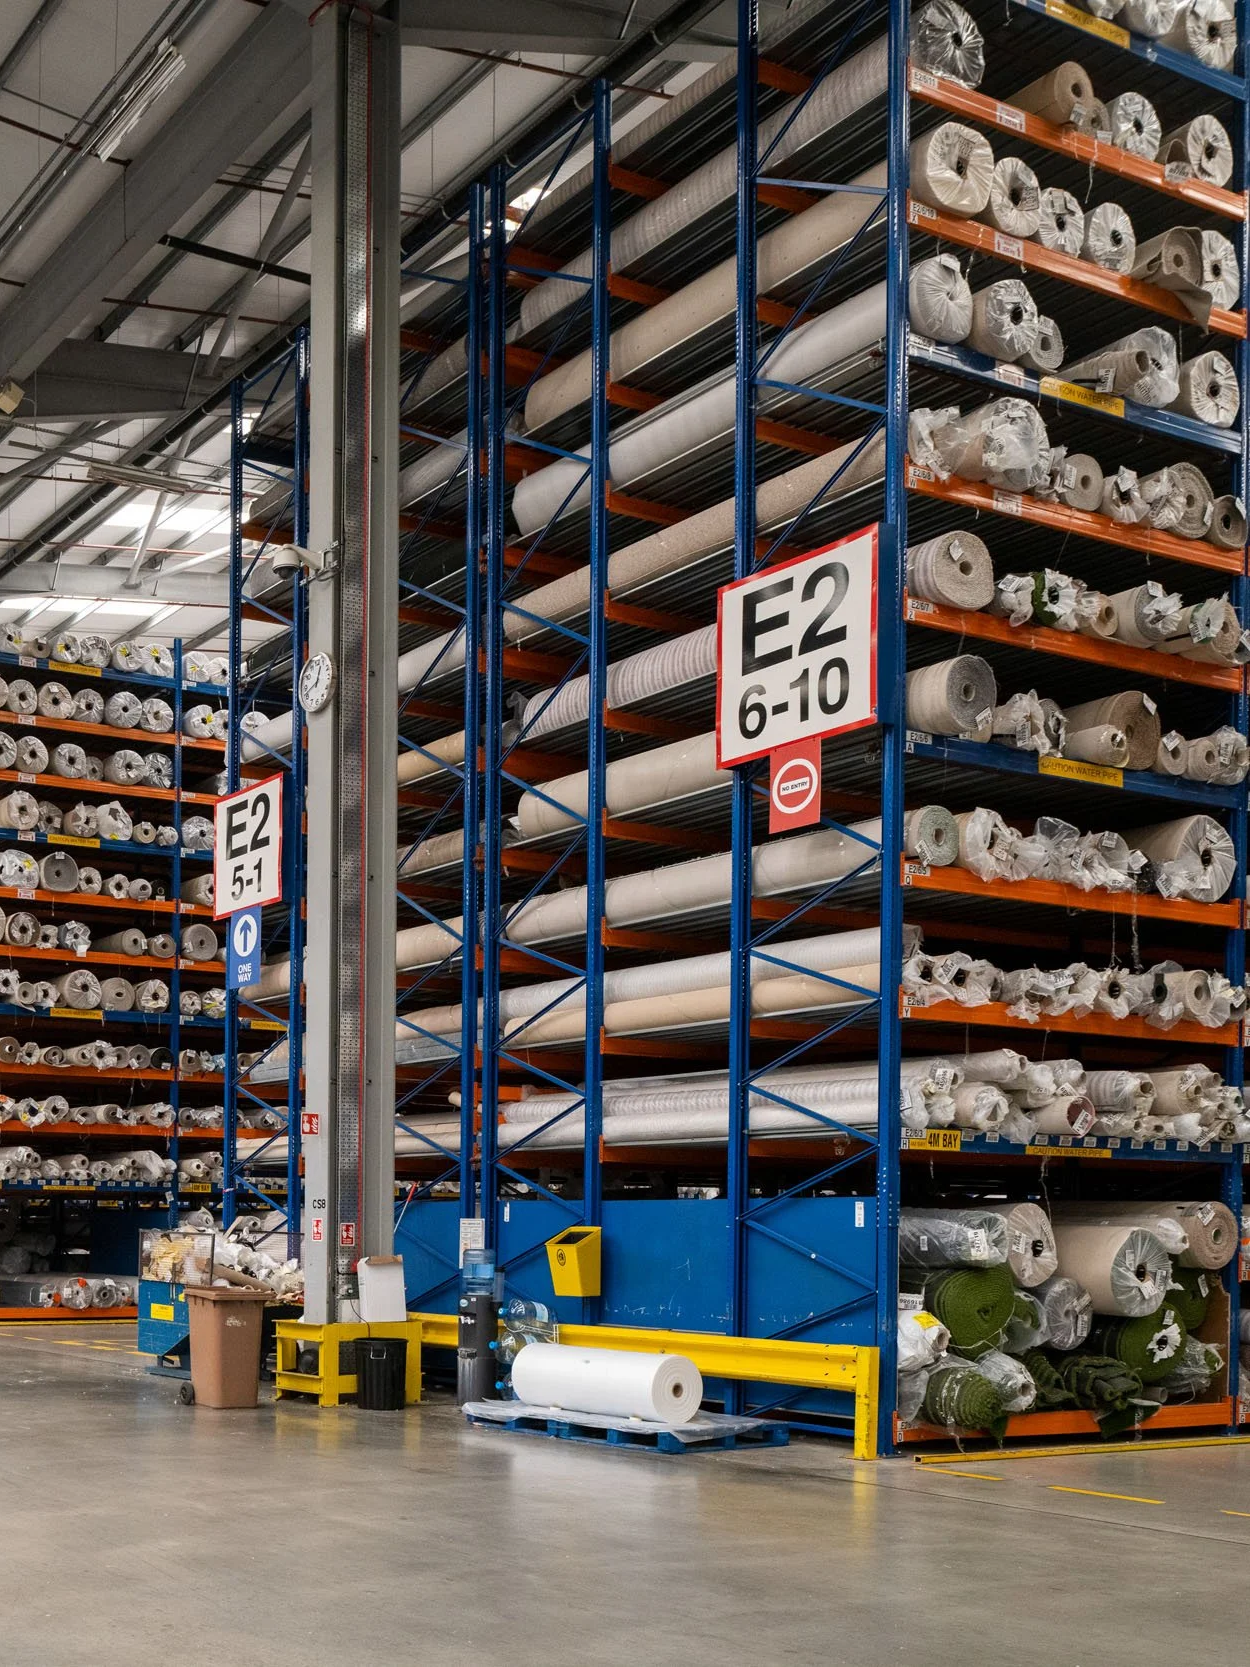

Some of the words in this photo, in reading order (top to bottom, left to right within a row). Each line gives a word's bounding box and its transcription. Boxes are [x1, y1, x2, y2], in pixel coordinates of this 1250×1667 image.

[913, 203, 935, 218] E2/6/10
[912, 213, 918, 223] X
[1076, 389, 1102, 405] WATER
[913, 467, 931, 480] E2/6/8
[912, 600, 929, 611] E2/6/7
[742, 562, 850, 676] E2
[738, 657, 850, 740] 6-10
[911, 732, 928, 743] E2/6/6
[907, 743, 912, 752] A
[1041, 759, 1074, 773] CAUTION
[1075, 766, 1101, 777] WATER
[1103, 771, 1118, 782] PIPE
[791, 781, 808, 790] ENTRY
[226, 792, 271, 861] E2
[908, 864, 926, 876] E2/6/5
[231, 857, 263, 901] 5-1
[905, 875, 911, 885] Q
[238, 963, 252, 974] ONE
[237, 972, 252, 983] WAY
[907, 997, 926, 1007] E2/6/4
[904, 1008, 909, 1017] Y
[905, 1129, 923, 1138] E2/6/3
[902, 1140, 907, 1148] H
[928, 1133, 940, 1148] 4M
[942, 1134, 958, 1149] BAY
[1032, 1147, 1062, 1155] CAUTION
[1063, 1147, 1087, 1156] WATER
[1088, 1149, 1103, 1157] PIPE
[313, 1199, 326, 1209] CS8
